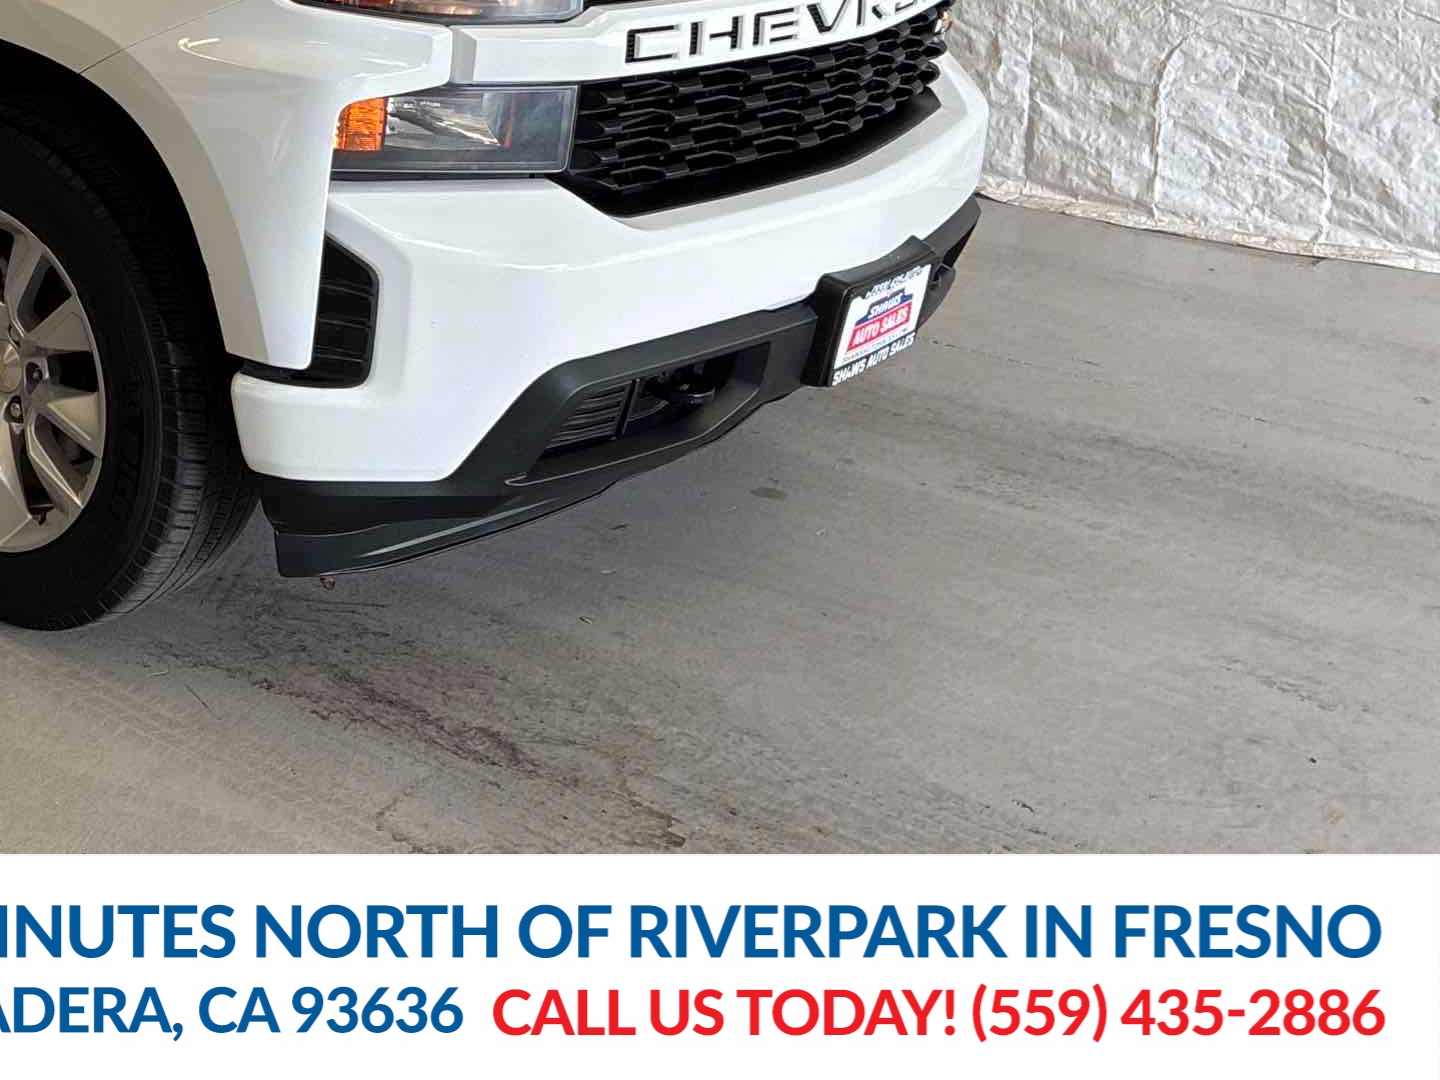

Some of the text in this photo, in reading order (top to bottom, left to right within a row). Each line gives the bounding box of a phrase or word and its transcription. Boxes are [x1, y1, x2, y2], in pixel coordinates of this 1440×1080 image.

[852, 324, 879, 347] AUTO
[880, 307, 909, 334] SALES
[866, 347, 890, 369] AUTO
[889, 332, 916, 356] SALES
